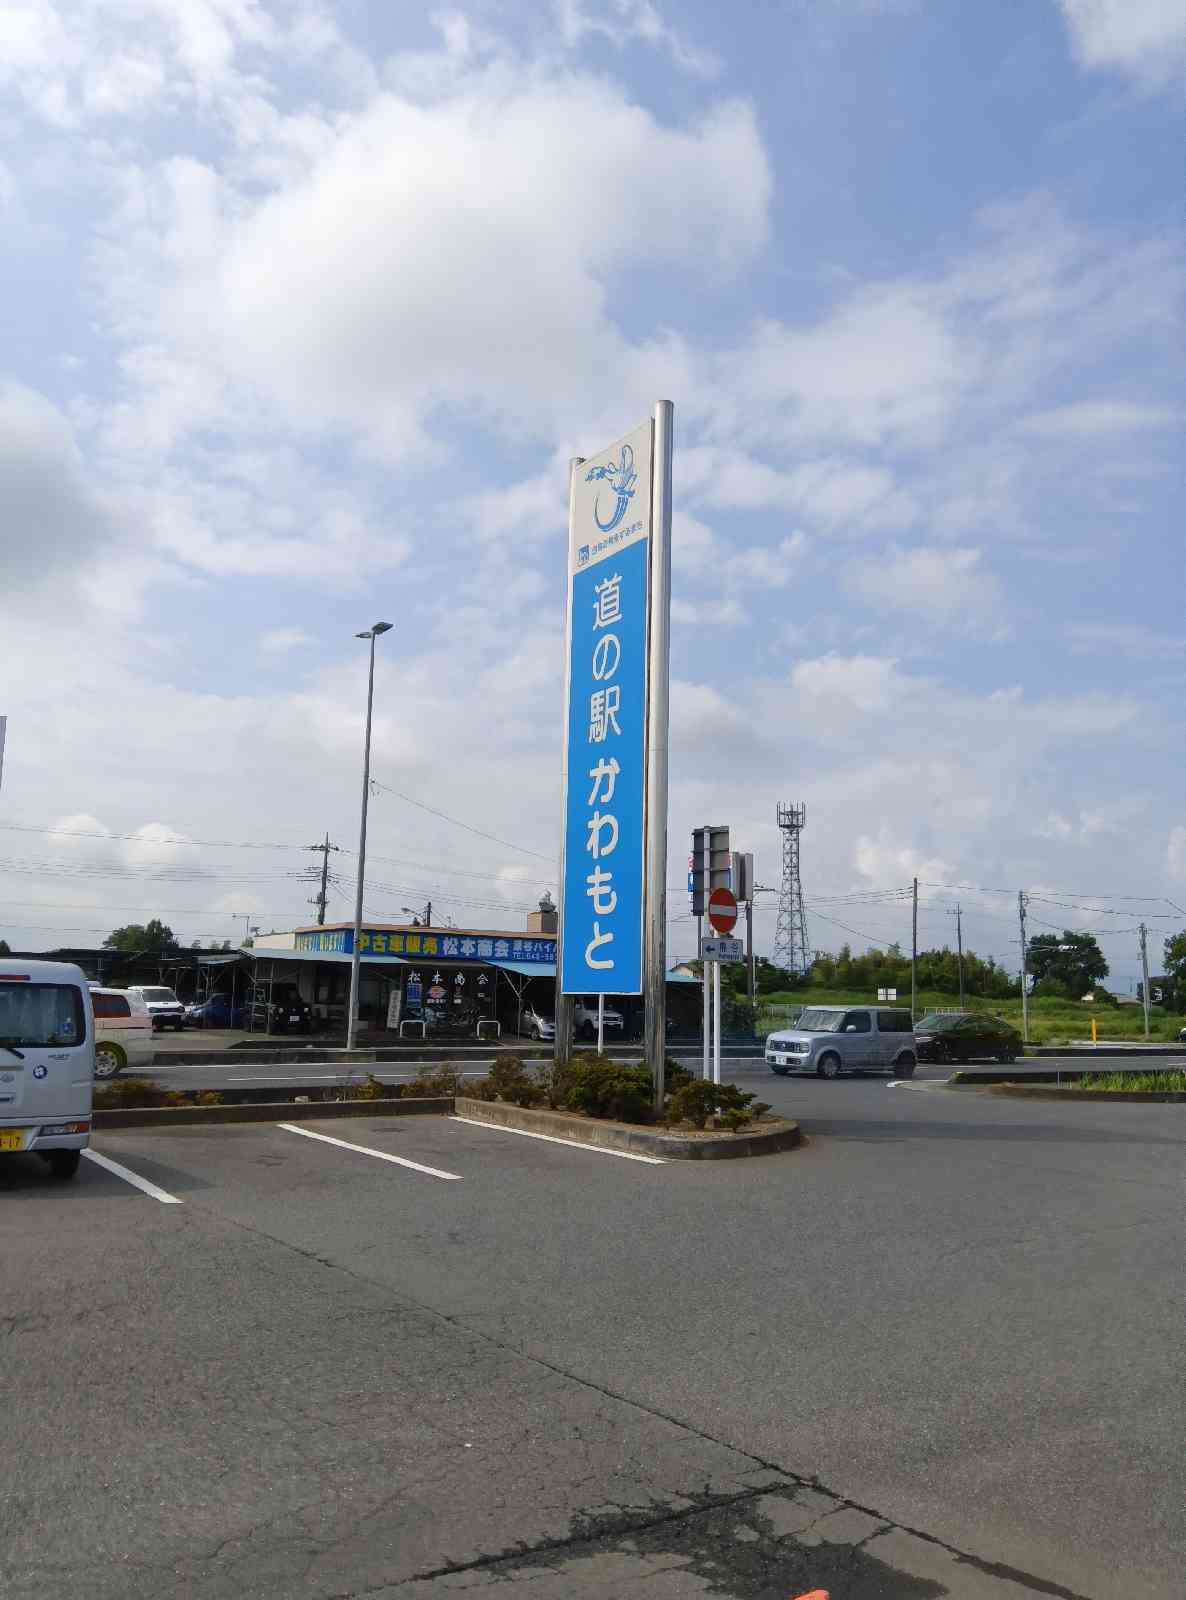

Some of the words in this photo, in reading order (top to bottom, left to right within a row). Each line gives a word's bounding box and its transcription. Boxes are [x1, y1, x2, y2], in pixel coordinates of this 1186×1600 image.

[588, 573, 623, 743] 道の駅
[584, 757, 621, 970] かわもと
